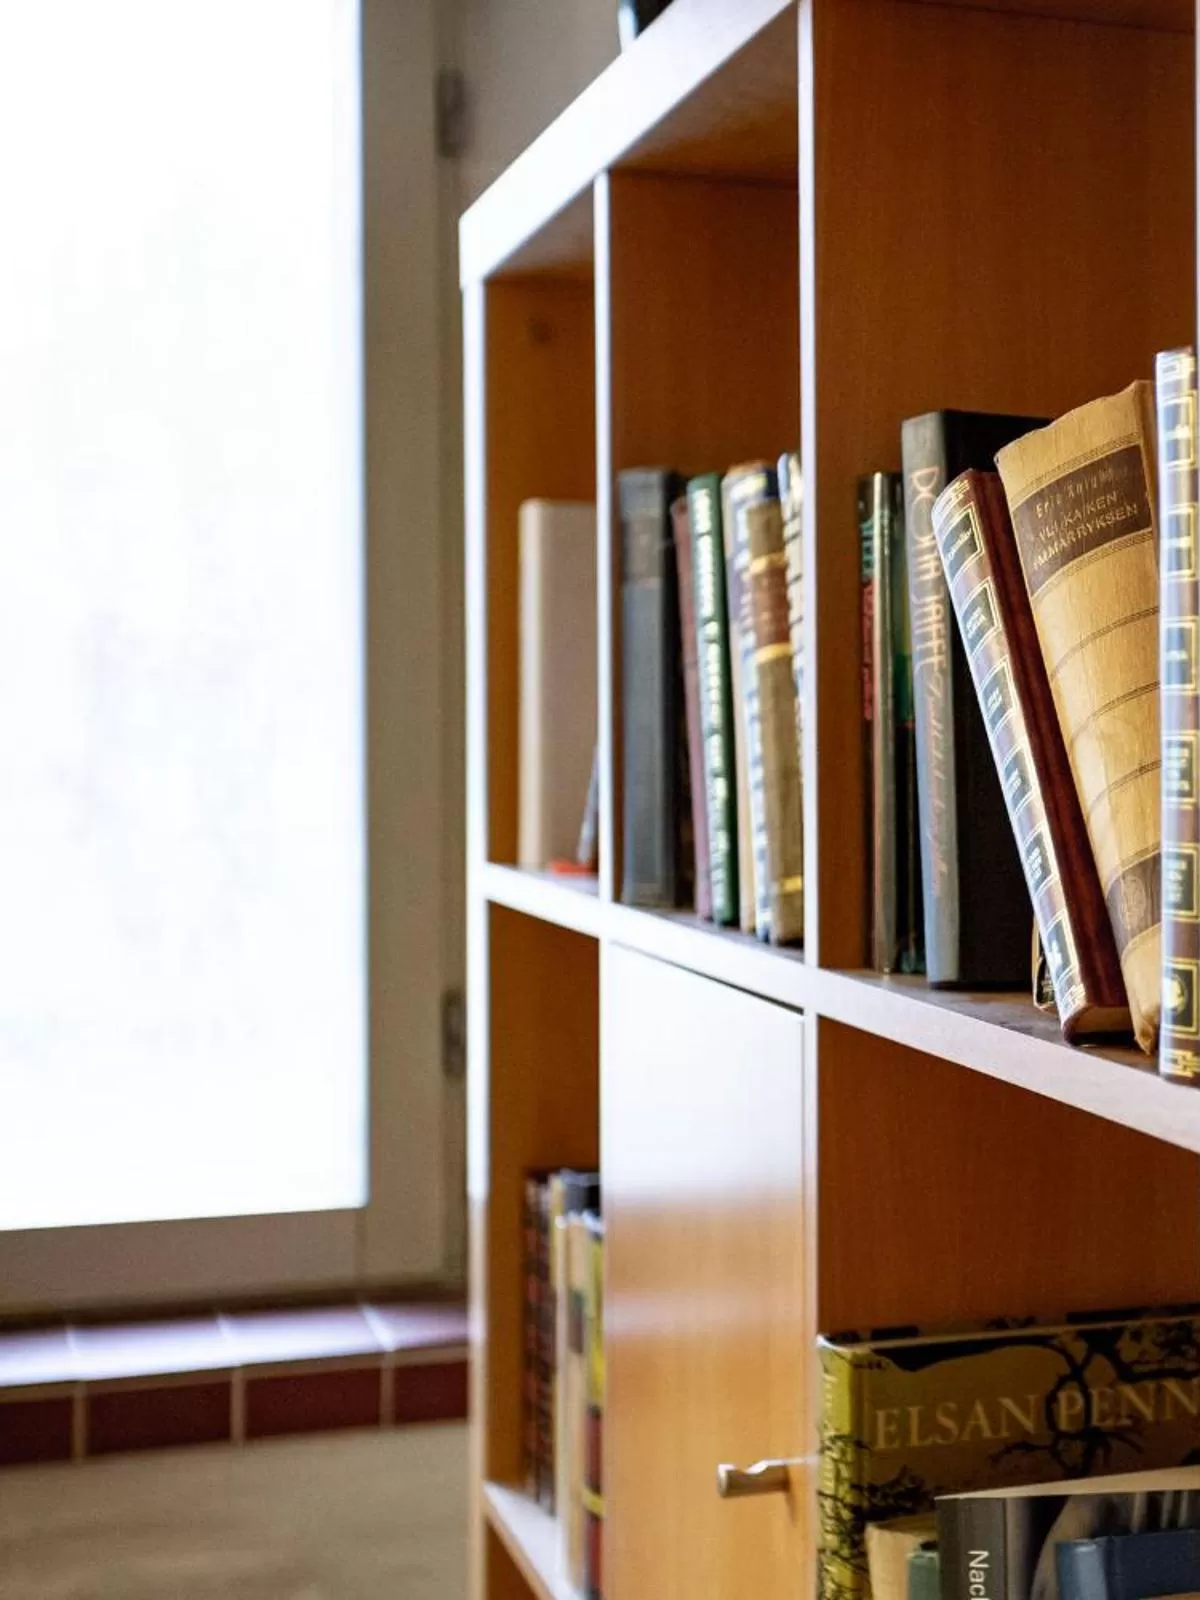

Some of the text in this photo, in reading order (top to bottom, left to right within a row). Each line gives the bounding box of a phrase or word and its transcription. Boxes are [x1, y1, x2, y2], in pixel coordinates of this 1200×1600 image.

[875, 1377, 1200, 1450] ELSAN PENN
[968, 1550, 989, 1600] Nac
